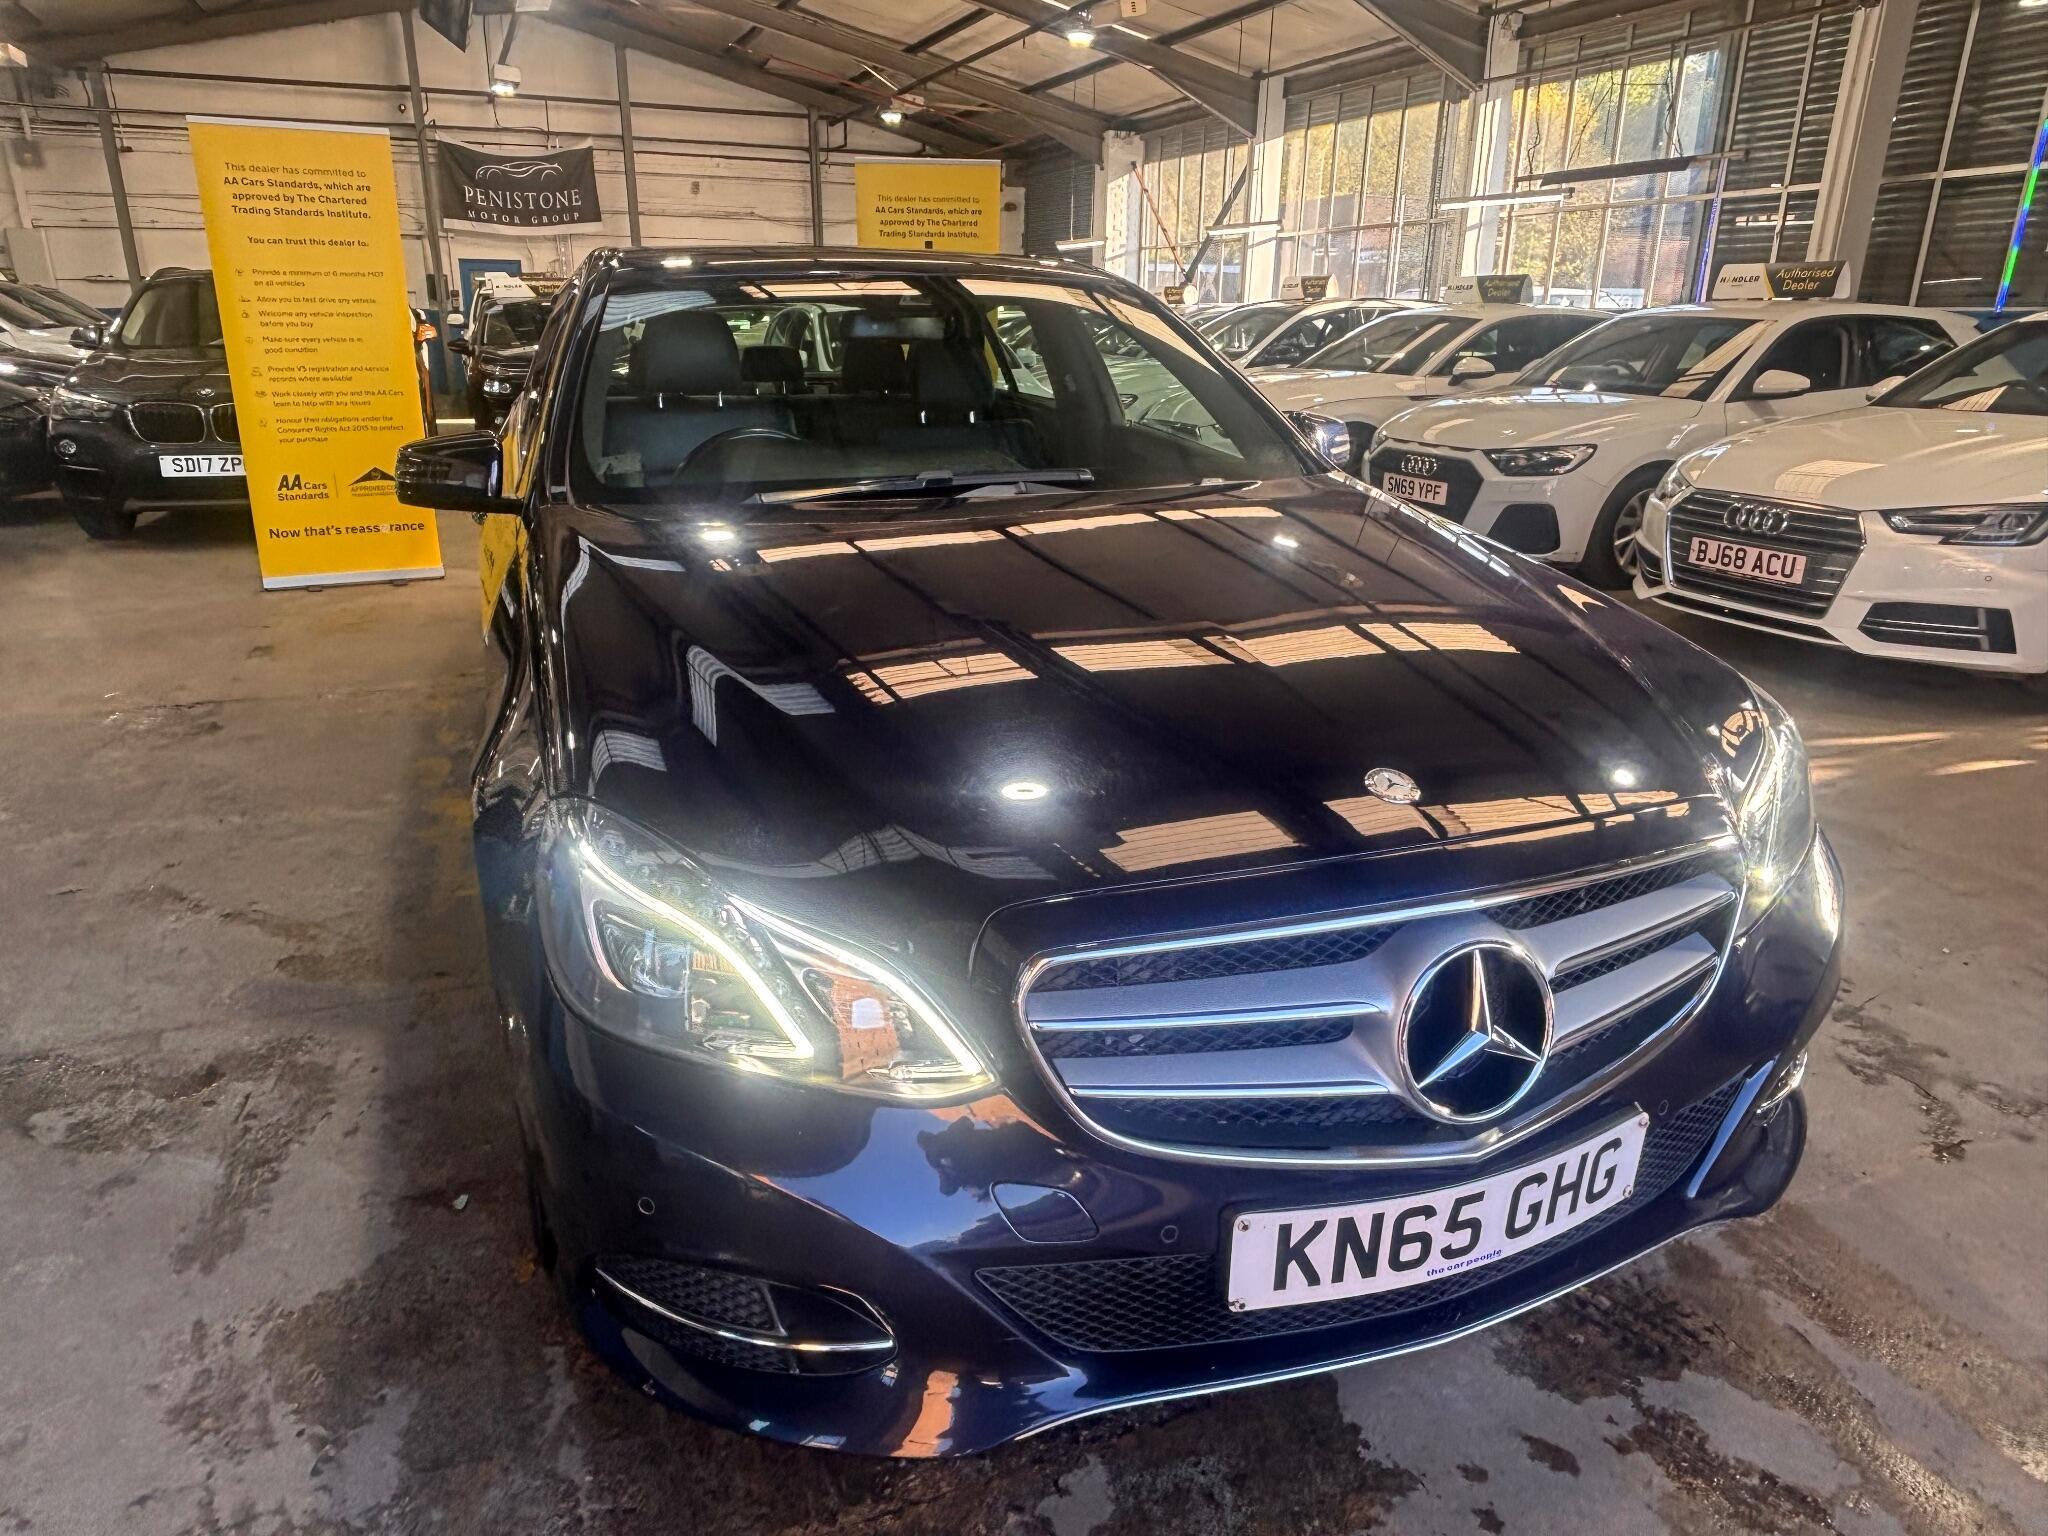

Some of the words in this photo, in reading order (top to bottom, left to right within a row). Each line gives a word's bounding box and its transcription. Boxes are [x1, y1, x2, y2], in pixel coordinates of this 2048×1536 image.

[225, 162, 246, 172] This
[249, 164, 279, 173] dealer
[283, 166, 299, 175] has
[303, 167, 353, 177] committed
[357, 170, 366, 178] to
[224, 177, 238, 185] AA
[242, 178, 264, 187] Cars
[268, 179, 322, 190] Standards,
[324, 182, 353, 191] which
[233, 192, 280, 202] approved
[283, 194, 294, 203] by
[297, 194, 315, 202] The
[318, 195, 366, 205] Chartered
[464, 185, 581, 209] PENISTONE
[878, 194, 892, 202] This
[933, 195, 970, 203] committed
[232, 205, 270, 216] Trading
[274, 207, 324, 217] Standards
[328, 209, 370, 219] Institute.
[468, 210, 520, 224] MOTOR
[532, 212, 580, 223] GROUP
[907, 207, 945, 215] Standards,
[917, 219, 925, 227] by
[248, 236, 264, 244] You
[310, 238, 325, 246] this
[879, 230, 906, 238] Trading
[1776, 266, 1836, 278] Authorised
[1783, 280, 1821, 291] Dealer
[172, 457, 212, 472] SD17
[218, 457, 242, 472] ZP
[278, 474, 302, 491] AA
[304, 482, 327, 490] Cars
[1388, 477, 1415, 496] SN69
[1419, 482, 1441, 500] YPF
[278, 492, 329, 501] Standards
[269, 528, 300, 538] Now
[305, 525, 341, 536] that's
[346, 522, 424, 534] reassrance
[1695, 541, 1747, 569] BJ68
[1751, 551, 1796, 578] ACU
[1273, 1191, 1486, 1291] KN65
[1504, 1137, 1623, 1240] GHG
[1427, 1268, 1444, 1276] the
[1447, 1261, 1465, 1271] car
[1466, 1249, 1501, 1266] people
